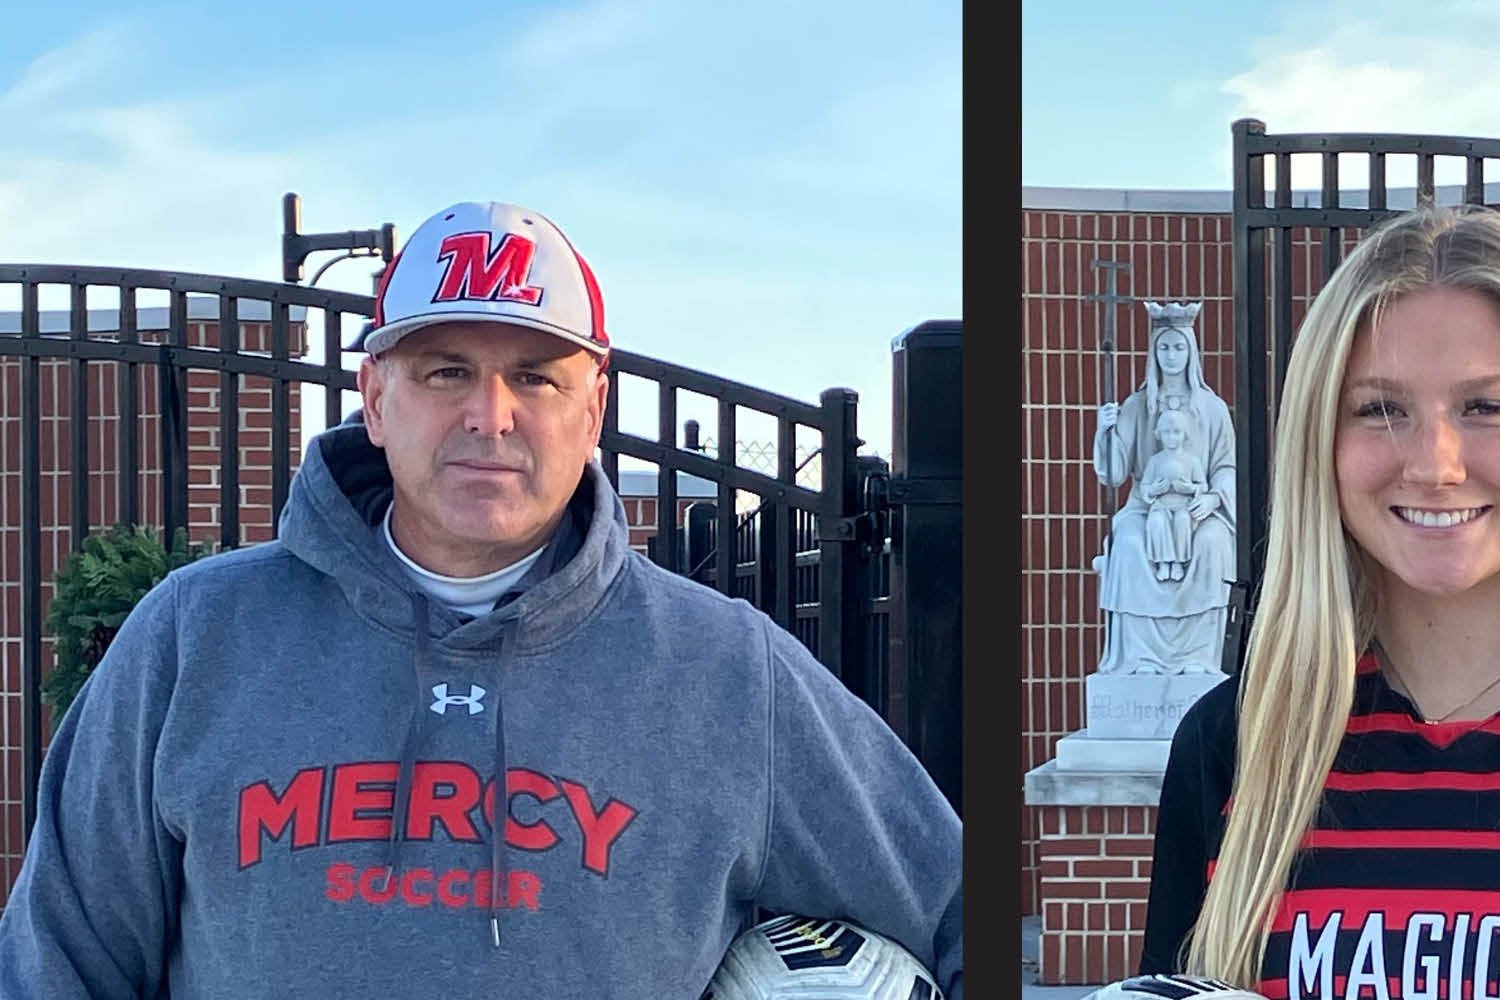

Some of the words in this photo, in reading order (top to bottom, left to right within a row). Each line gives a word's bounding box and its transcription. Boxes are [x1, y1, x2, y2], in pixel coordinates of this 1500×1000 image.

[430, 231, 545, 307] M
[238, 760, 640, 880] MERCY
[324, 861, 544, 911] SOCCER
